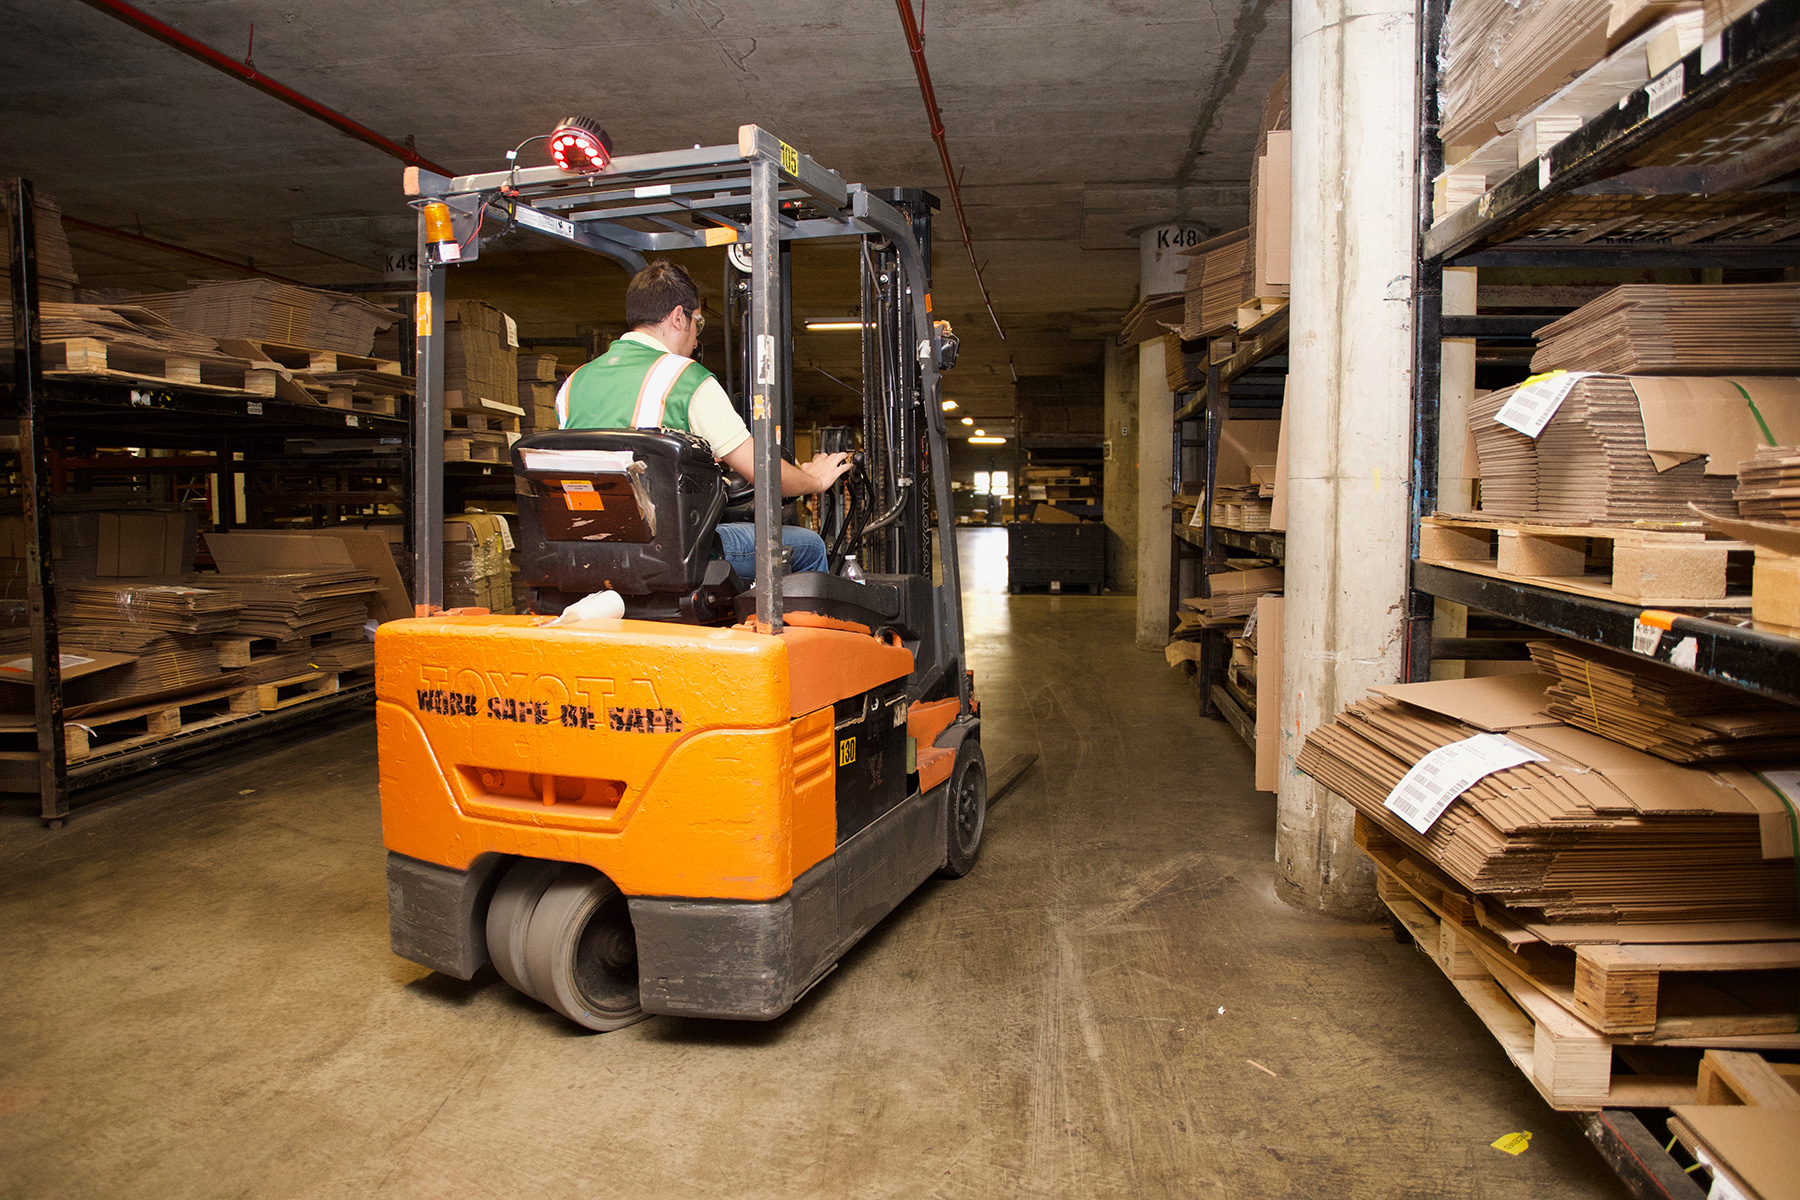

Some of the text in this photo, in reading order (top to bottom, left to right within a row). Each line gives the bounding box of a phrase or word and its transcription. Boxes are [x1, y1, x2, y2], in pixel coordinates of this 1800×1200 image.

[780, 144, 797, 174] 105
[1157, 229, 1197, 248] K48
[385, 254, 418, 273] K49
[420, 663, 669, 728] TOYOTA
[416, 689, 682, 735] WORK SAFE BE SAFE
[841, 739, 855, 764] 130
